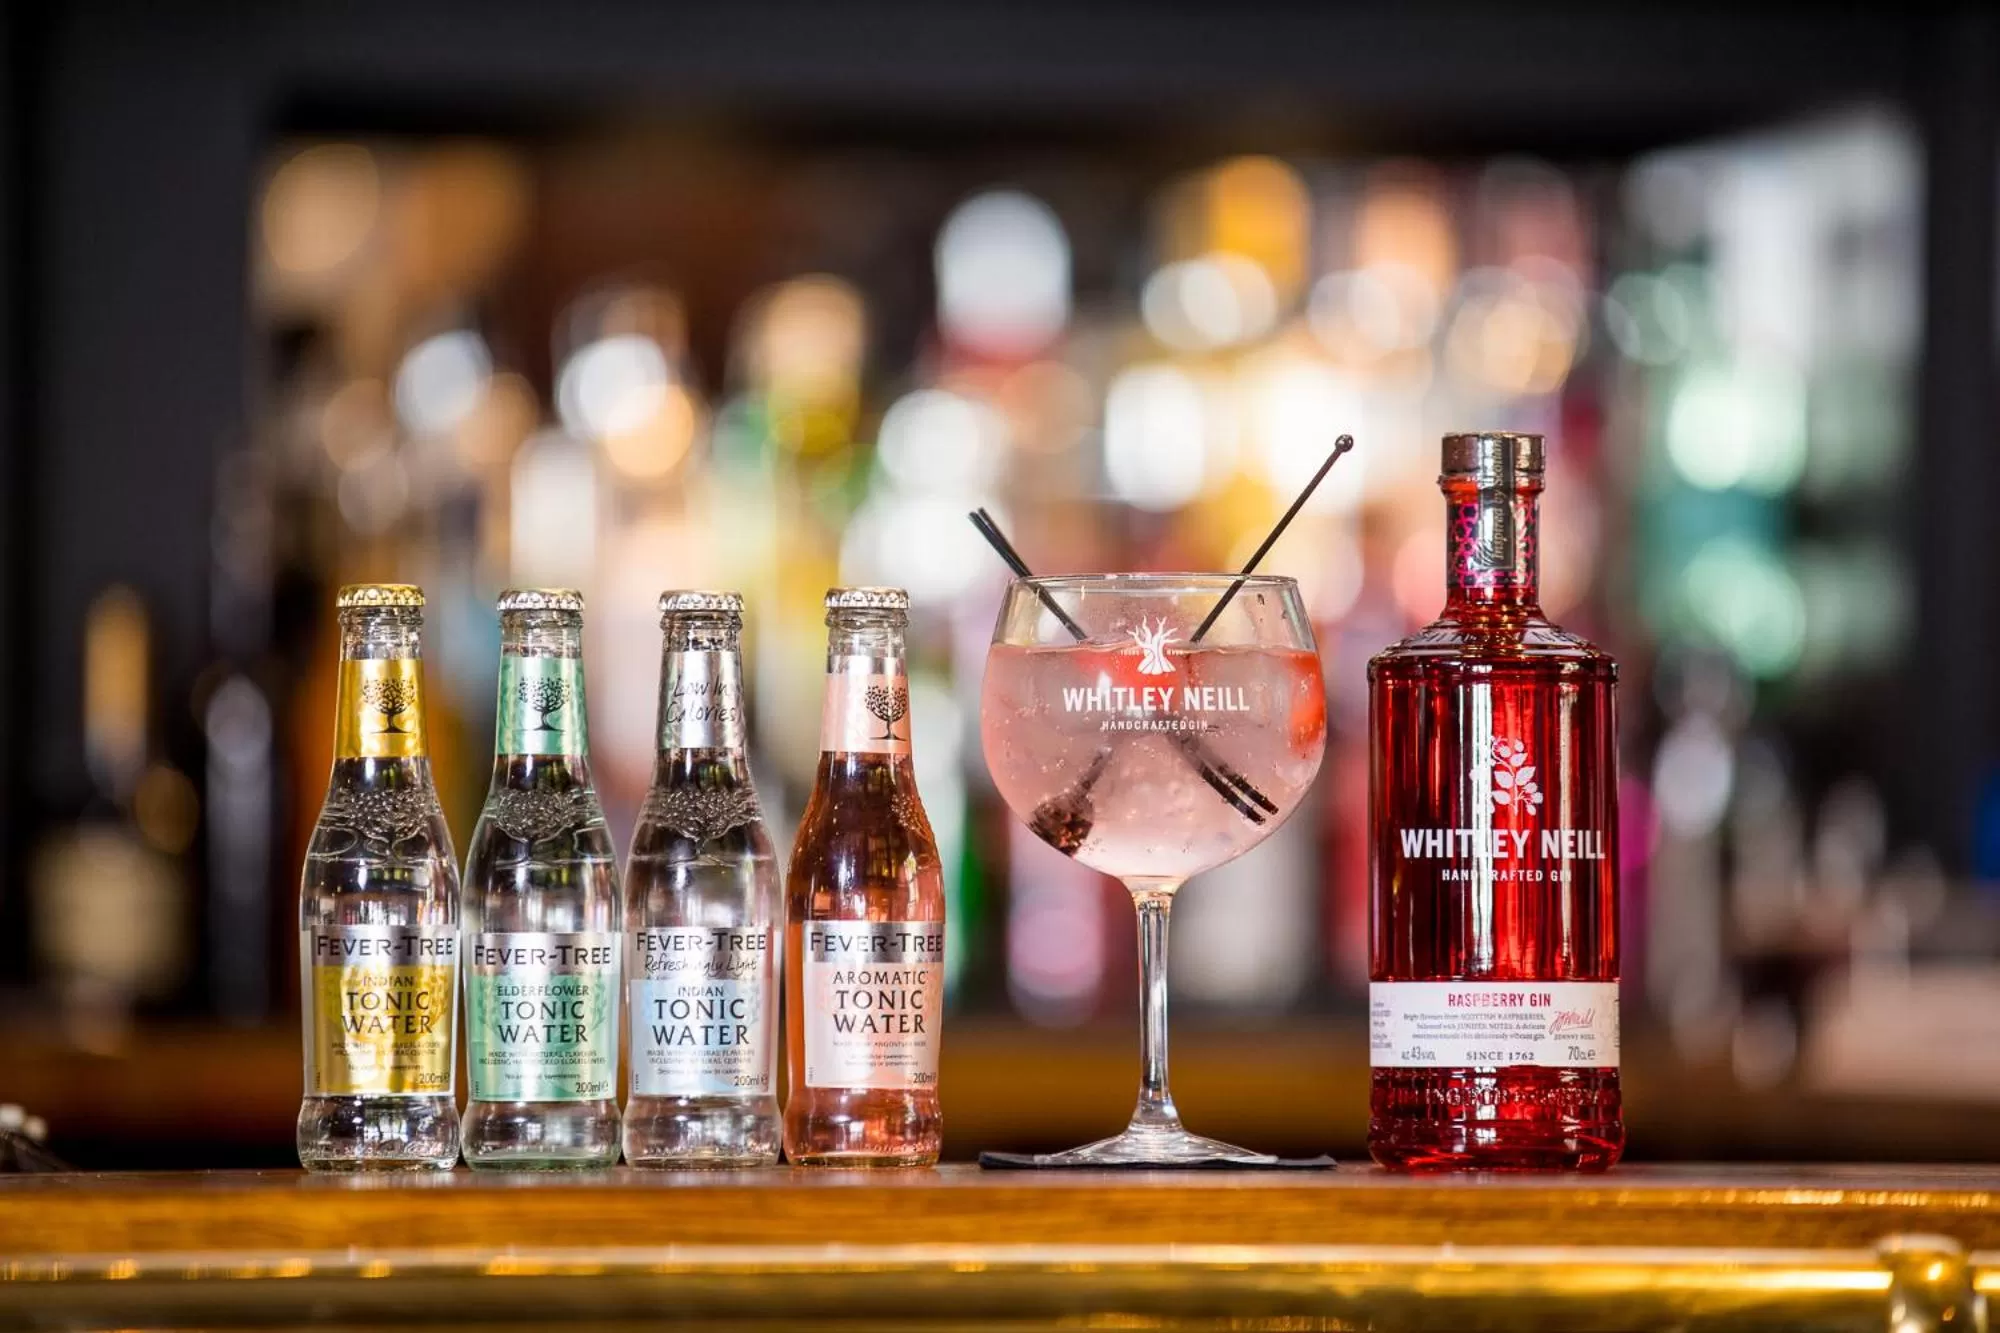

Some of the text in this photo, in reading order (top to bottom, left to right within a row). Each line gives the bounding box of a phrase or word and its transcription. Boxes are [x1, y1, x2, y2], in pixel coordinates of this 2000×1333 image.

[1063, 687, 1250, 712] WHITLEY NEILL
[666, 701, 736, 723] Calories
[1400, 829, 1606, 860] WHITLEY NEILL
[1442, 869, 1572, 882] HANDRAFTED GIN
[317, 935, 454, 956] FEVER-TREE
[637, 932, 766, 951] FEVER-TREE
[810, 932, 943, 952] FEVER-TREE
[474, 945, 611, 965] FEVER-TREE
[363, 975, 415, 987] INDIAN
[833, 971, 926, 985] AROMATIC
[346, 991, 429, 1011] TONIC
[497, 985, 589, 997] ELDERFLOWER
[677, 986, 725, 997] INDIAN
[836, 990, 923, 1010] TONIC
[1448, 993, 1552, 1008] RASPBERRY GIN
[501, 1000, 585, 1020] TONIC
[654, 999, 745, 1020] TONIC
[342, 1015, 433, 1034] WATER
[498, 1024, 588, 1044] WATER
[833, 1014, 926, 1034] WATER
[652, 1025, 750, 1046] WATER
[1466, 1051, 1535, 1061] SINCE 1762
